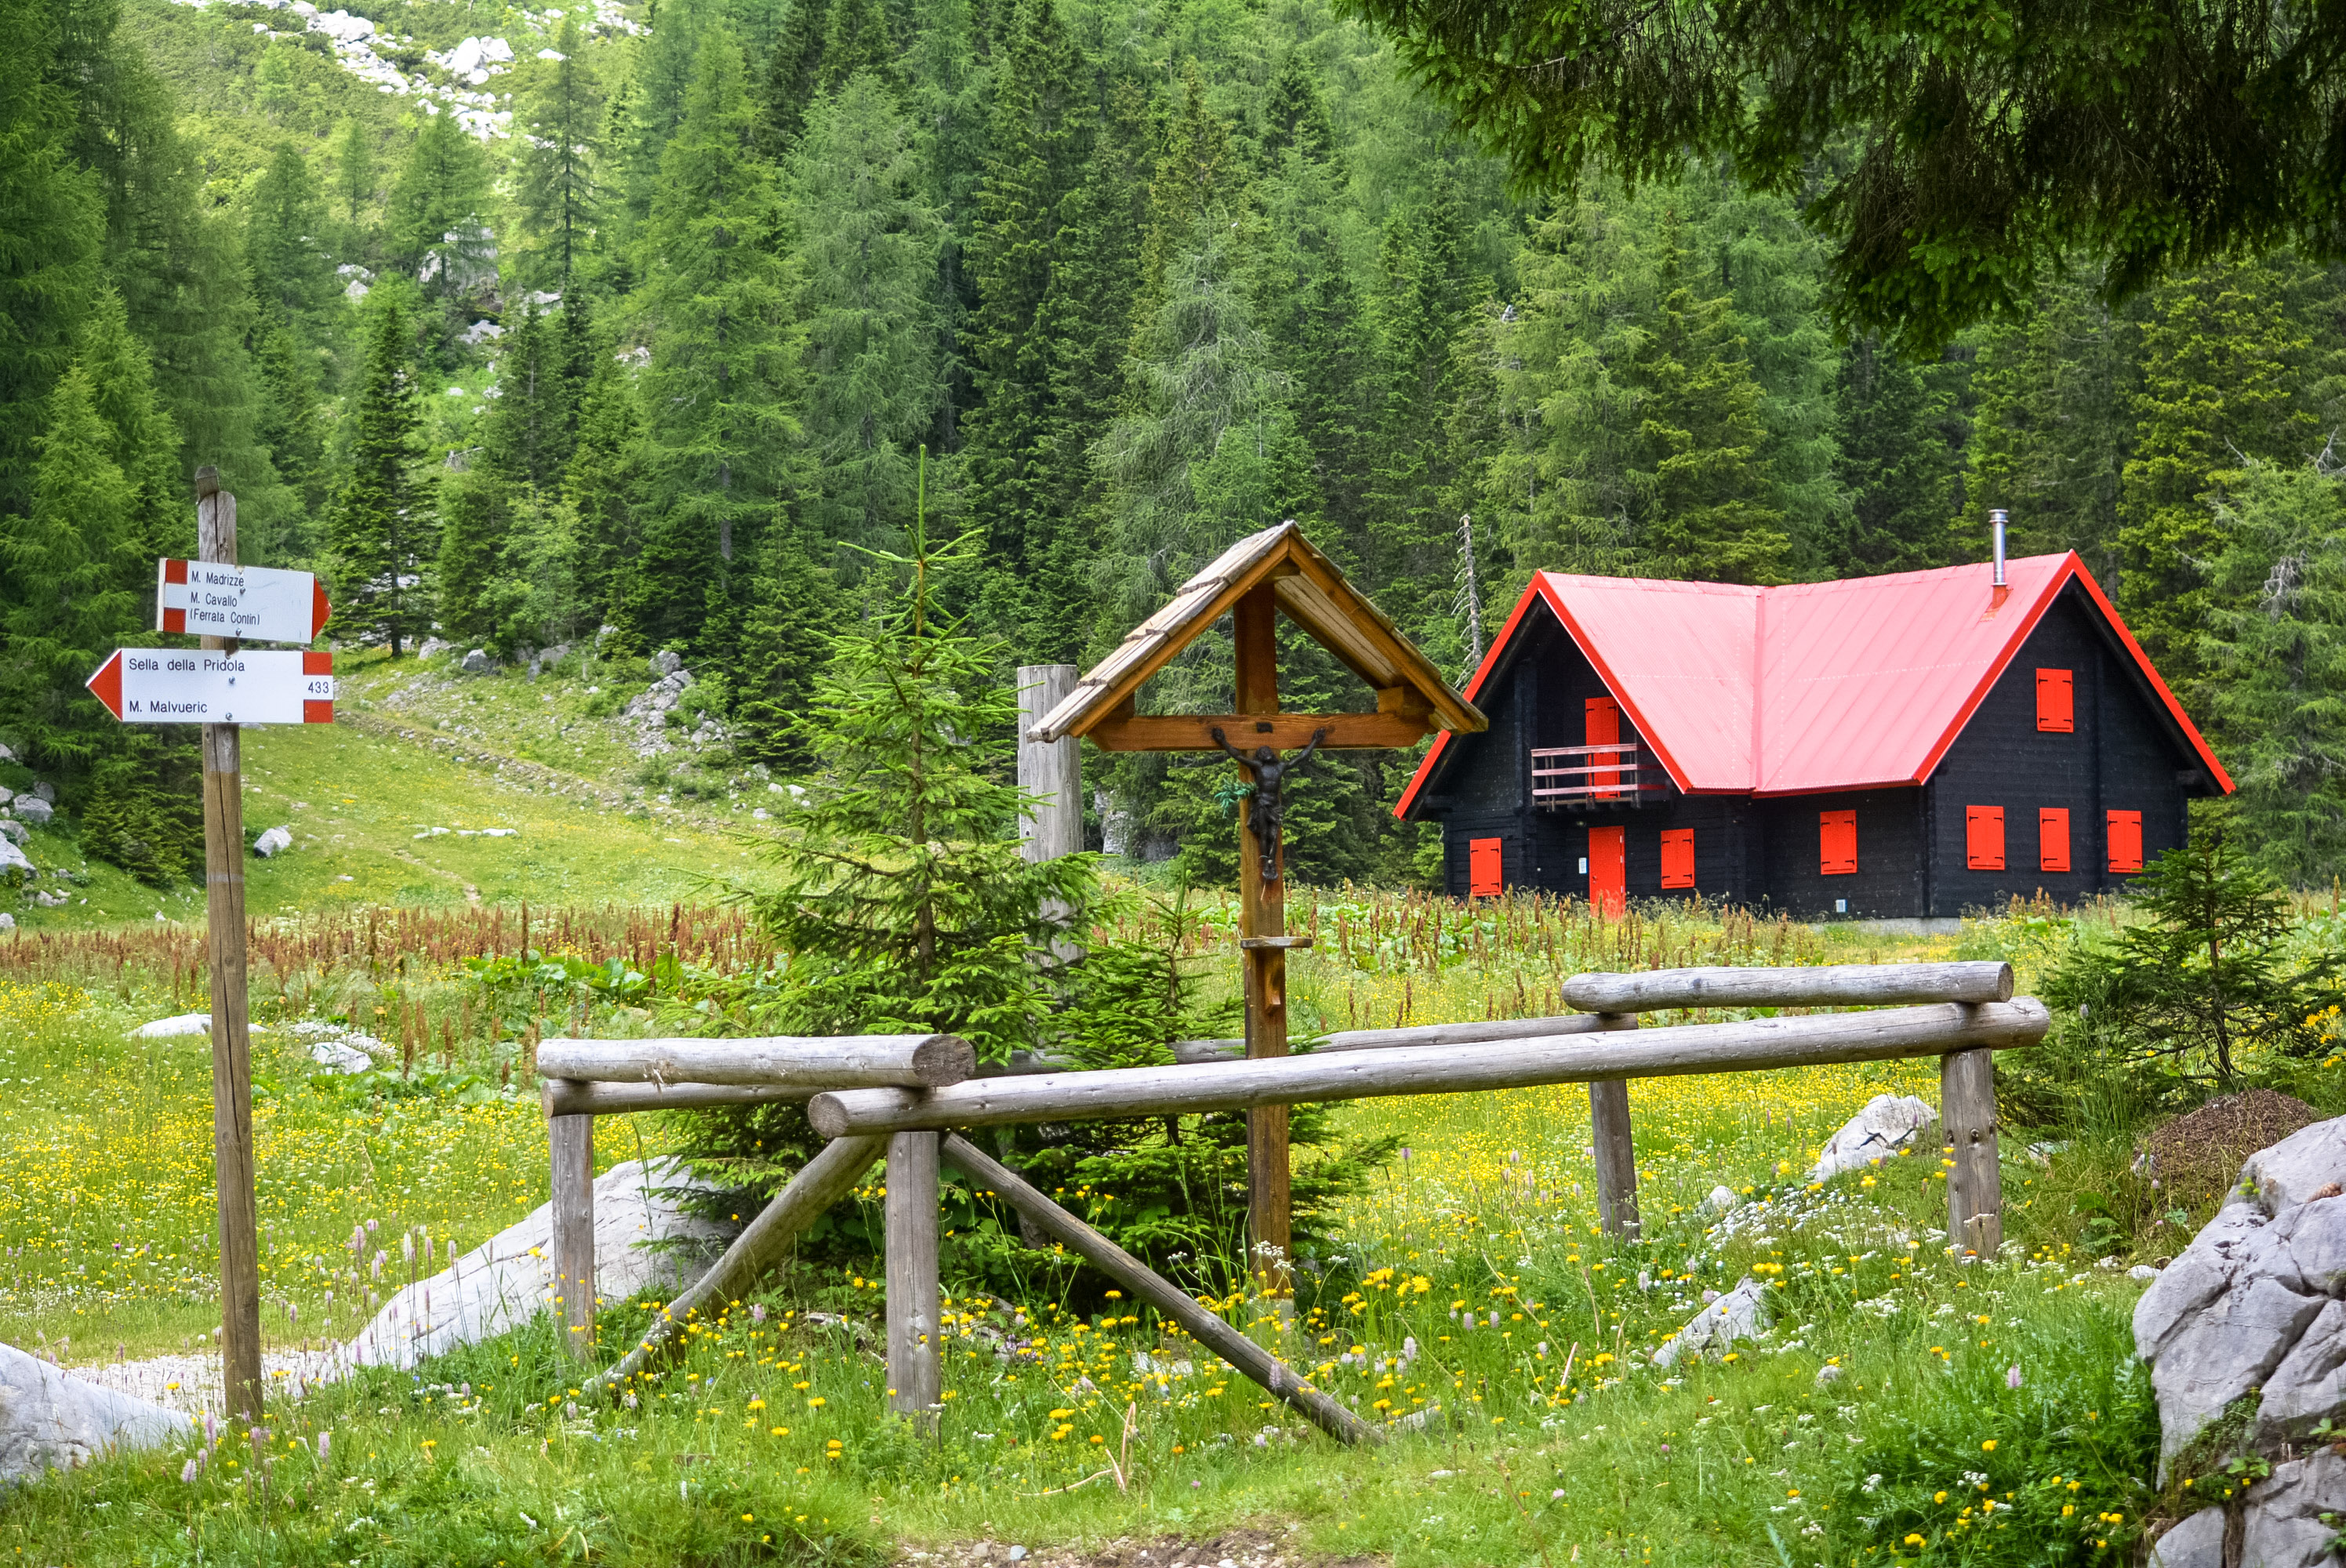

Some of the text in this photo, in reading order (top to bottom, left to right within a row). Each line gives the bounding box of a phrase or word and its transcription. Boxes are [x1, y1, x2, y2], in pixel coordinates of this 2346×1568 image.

[191, 572, 244, 586] M. Madrizze
[191, 592, 238, 607] M. Cavallo
[190, 608, 260, 625] (Ferrata Contin)
[129, 659, 245, 671] Sella della Pridola
[308, 682, 329, 693] 433
[129, 701, 207, 713] M. Malvueric
